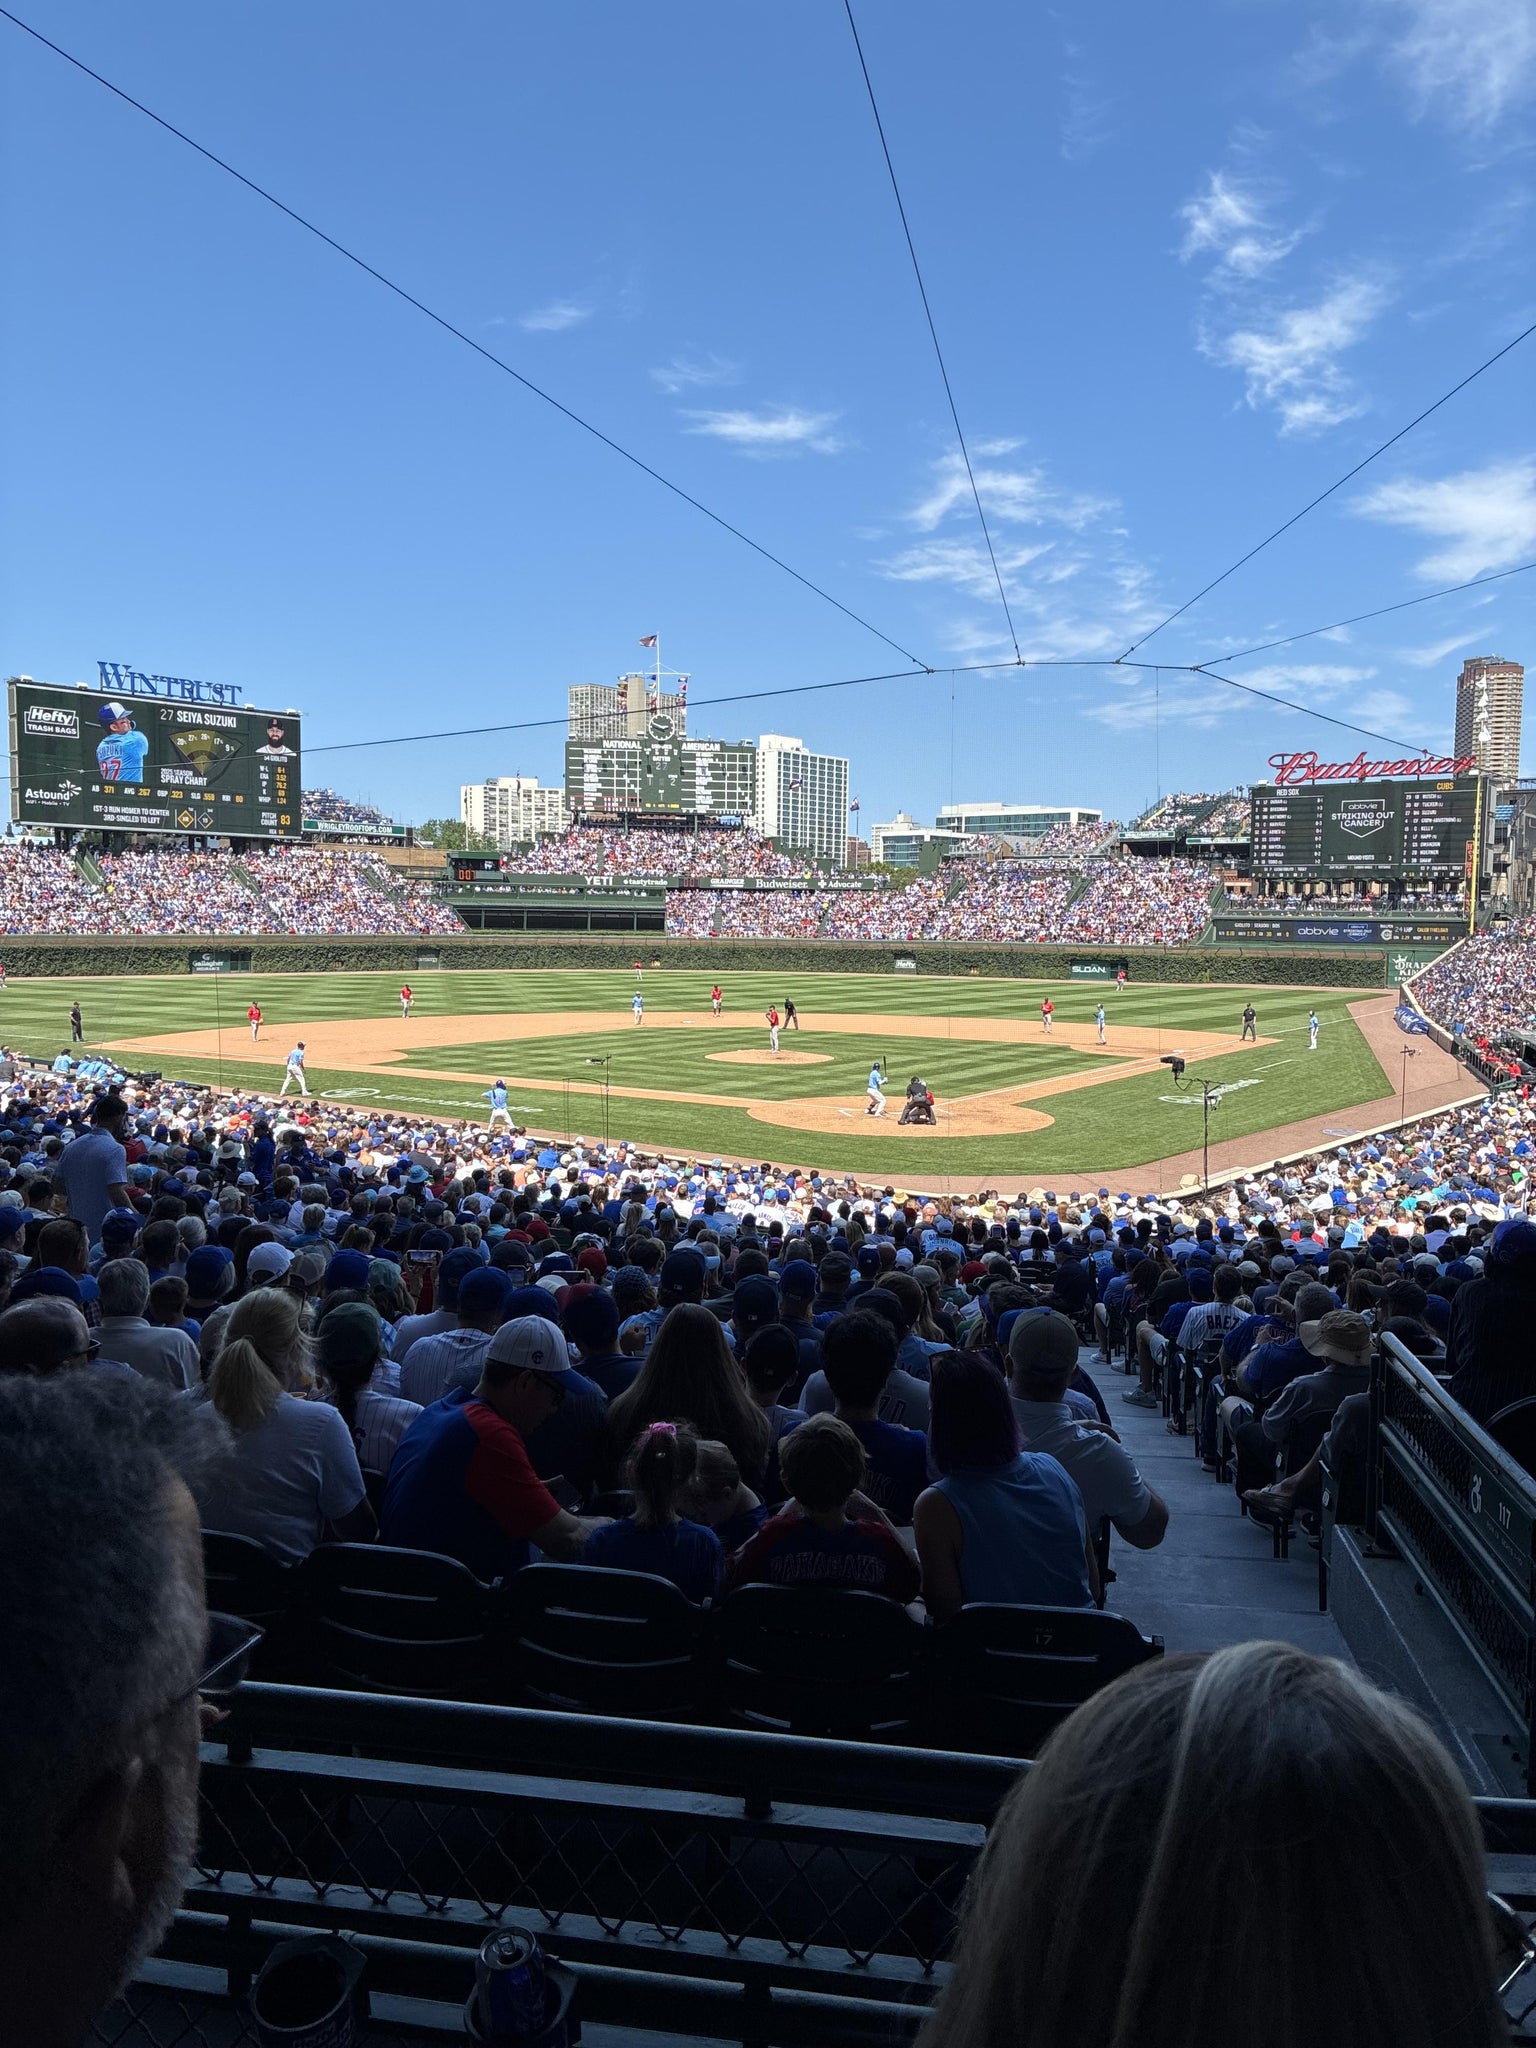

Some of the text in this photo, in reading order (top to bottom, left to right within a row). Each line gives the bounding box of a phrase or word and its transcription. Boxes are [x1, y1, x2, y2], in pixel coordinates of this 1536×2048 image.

[97, 661, 242, 705] WINTRUST
[32, 709, 72, 724] Hefty
[160, 709, 237, 728] 27 SEIYA SUZUKI
[28, 724, 77, 735] TRASH BAGS
[603, 740, 642, 749] NATIONAL
[682, 743, 720, 751] AMERICAN
[656, 762, 668, 771] 27
[1268, 751, 1476, 785] Budweiser
[174, 768, 193, 776] SEASON
[161, 775, 207, 786] SPRAY CHART
[670, 778, 676, 787] 2
[104, 786, 115, 794] 371
[124, 787, 135, 795] AVG
[1437, 782, 1454, 790] CUBS
[26, 788, 70, 800] Astound
[121, 807, 140, 815] HOMER
[149, 809, 170, 817] CENTER
[1332, 812, 1375, 820] STRIKING
[281, 815, 291, 825] 83
[318, 822, 393, 834] WRIGLEYROOFTOPS.COM
[585, 876, 613, 886] YETI
[629, 878, 668, 887] tastytrade
[1298, 927, 1339, 936] abbvie
[1500, 1501, 1511, 1530] 117
